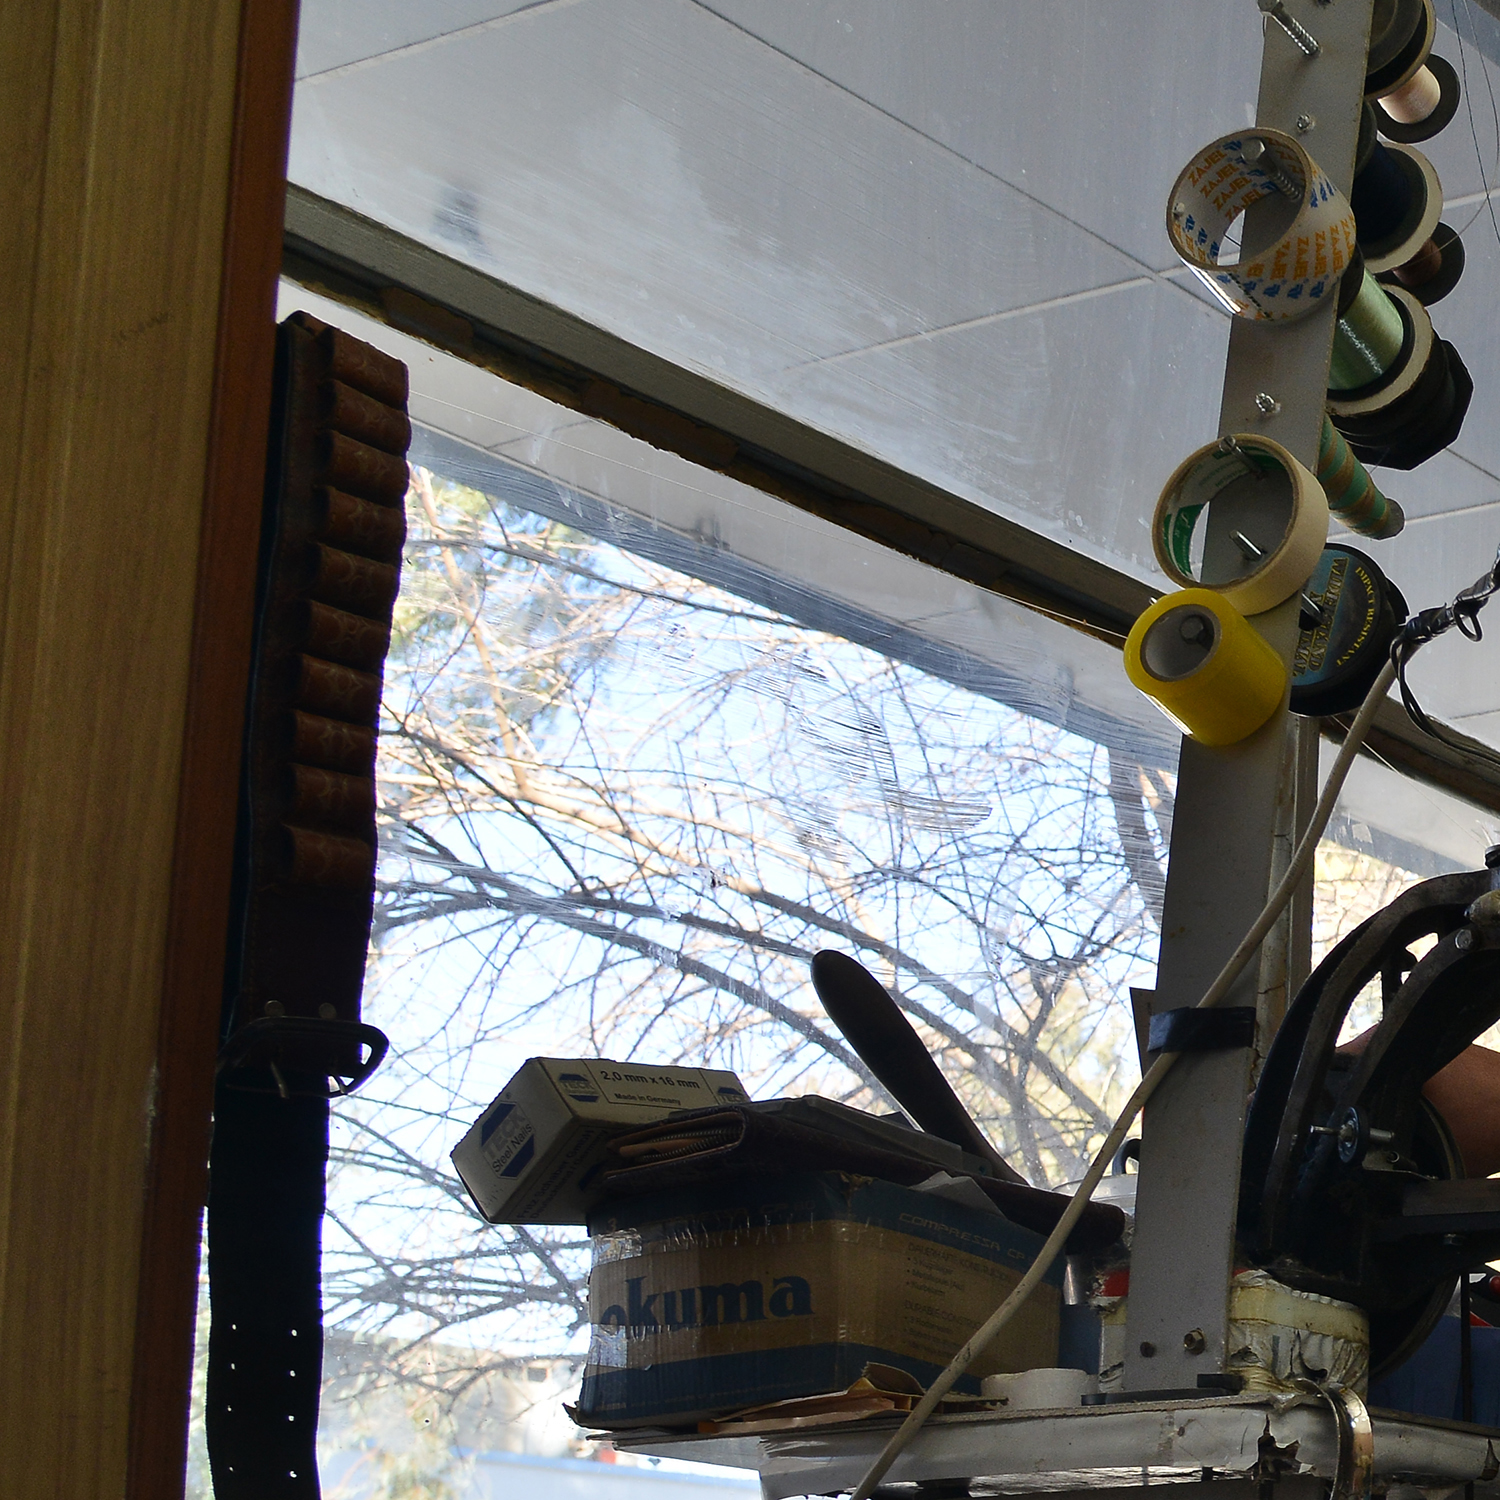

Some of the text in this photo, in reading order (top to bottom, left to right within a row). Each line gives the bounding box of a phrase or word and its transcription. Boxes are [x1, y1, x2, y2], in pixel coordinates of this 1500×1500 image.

[1187, 150, 1227, 188] ZAJEL
[1200, 163, 1240, 198] ZAJEL
[1213, 176, 1252, 211] ZAJEL
[1293, 236, 1310, 281] ZAJEL
[1314, 231, 1327, 278] ZAJEL
[1329, 225, 1344, 274] ZAJEL
[1336, 566, 1376, 667] IMPACT RESISTANT
[601, 1070, 621, 1082] 2,0
[624, 1074, 648, 1083] mm
[660, 1077, 674, 1086] 16
[677, 1079, 700, 1089] mm
[615, 1093, 636, 1101] Made
[647, 1095, 681, 1105] Germany
[492, 1123, 533, 1174] Steel Nails
[899, 1211, 1001, 1251] COMPRESSA
[601, 1275, 816, 1338] okuma
